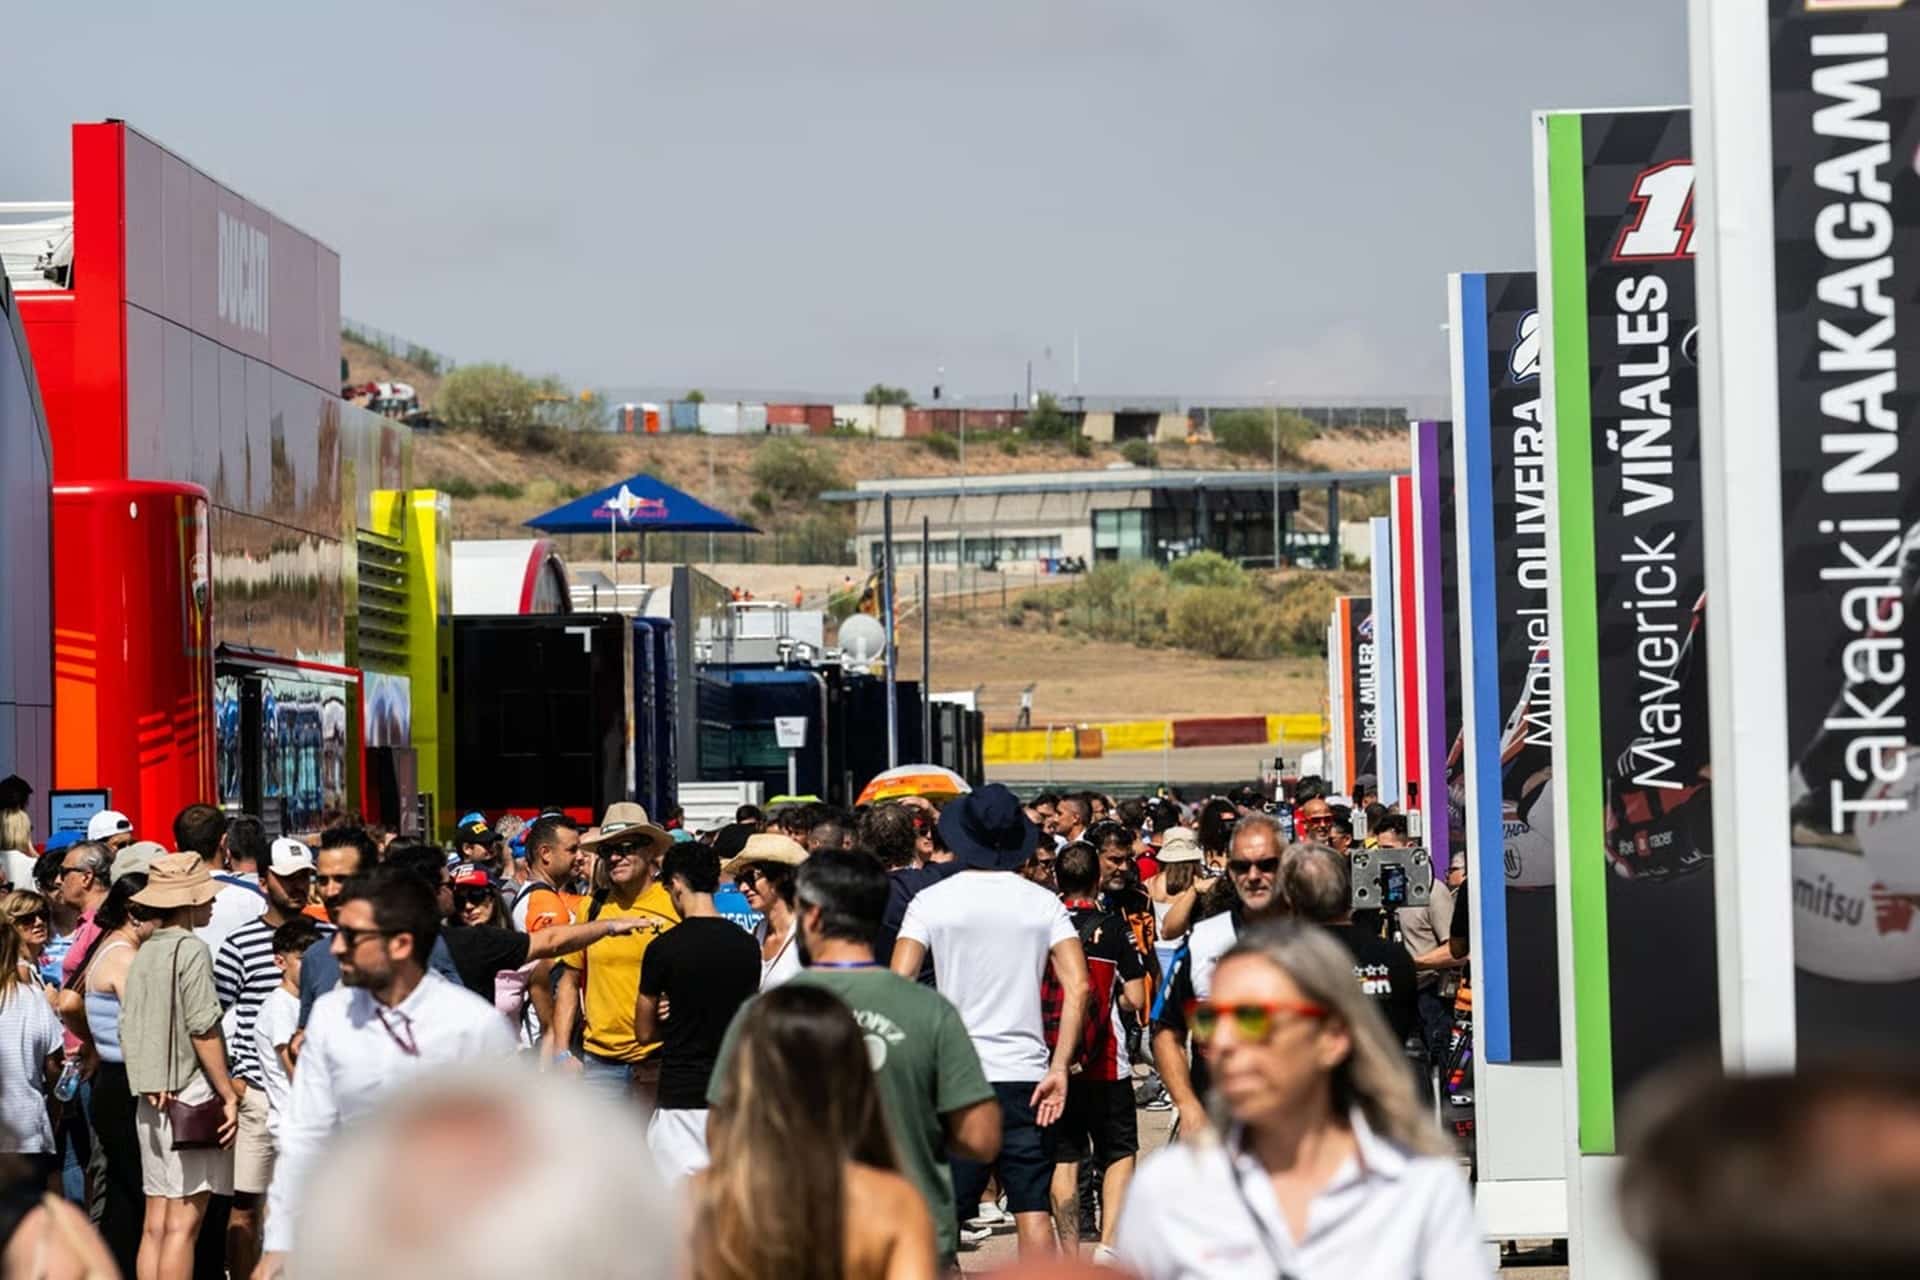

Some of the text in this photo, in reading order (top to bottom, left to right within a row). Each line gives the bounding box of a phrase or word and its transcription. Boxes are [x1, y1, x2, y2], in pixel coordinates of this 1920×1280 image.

[1612, 157, 1696, 262] 1
[1810, 32, 1902, 493] NAKAGAMI
[1358, 643, 1376, 705] MILLER
[1605, 275, 1684, 789] Maverick VIÑALES
[1818, 517, 1909, 835] Takaaki
